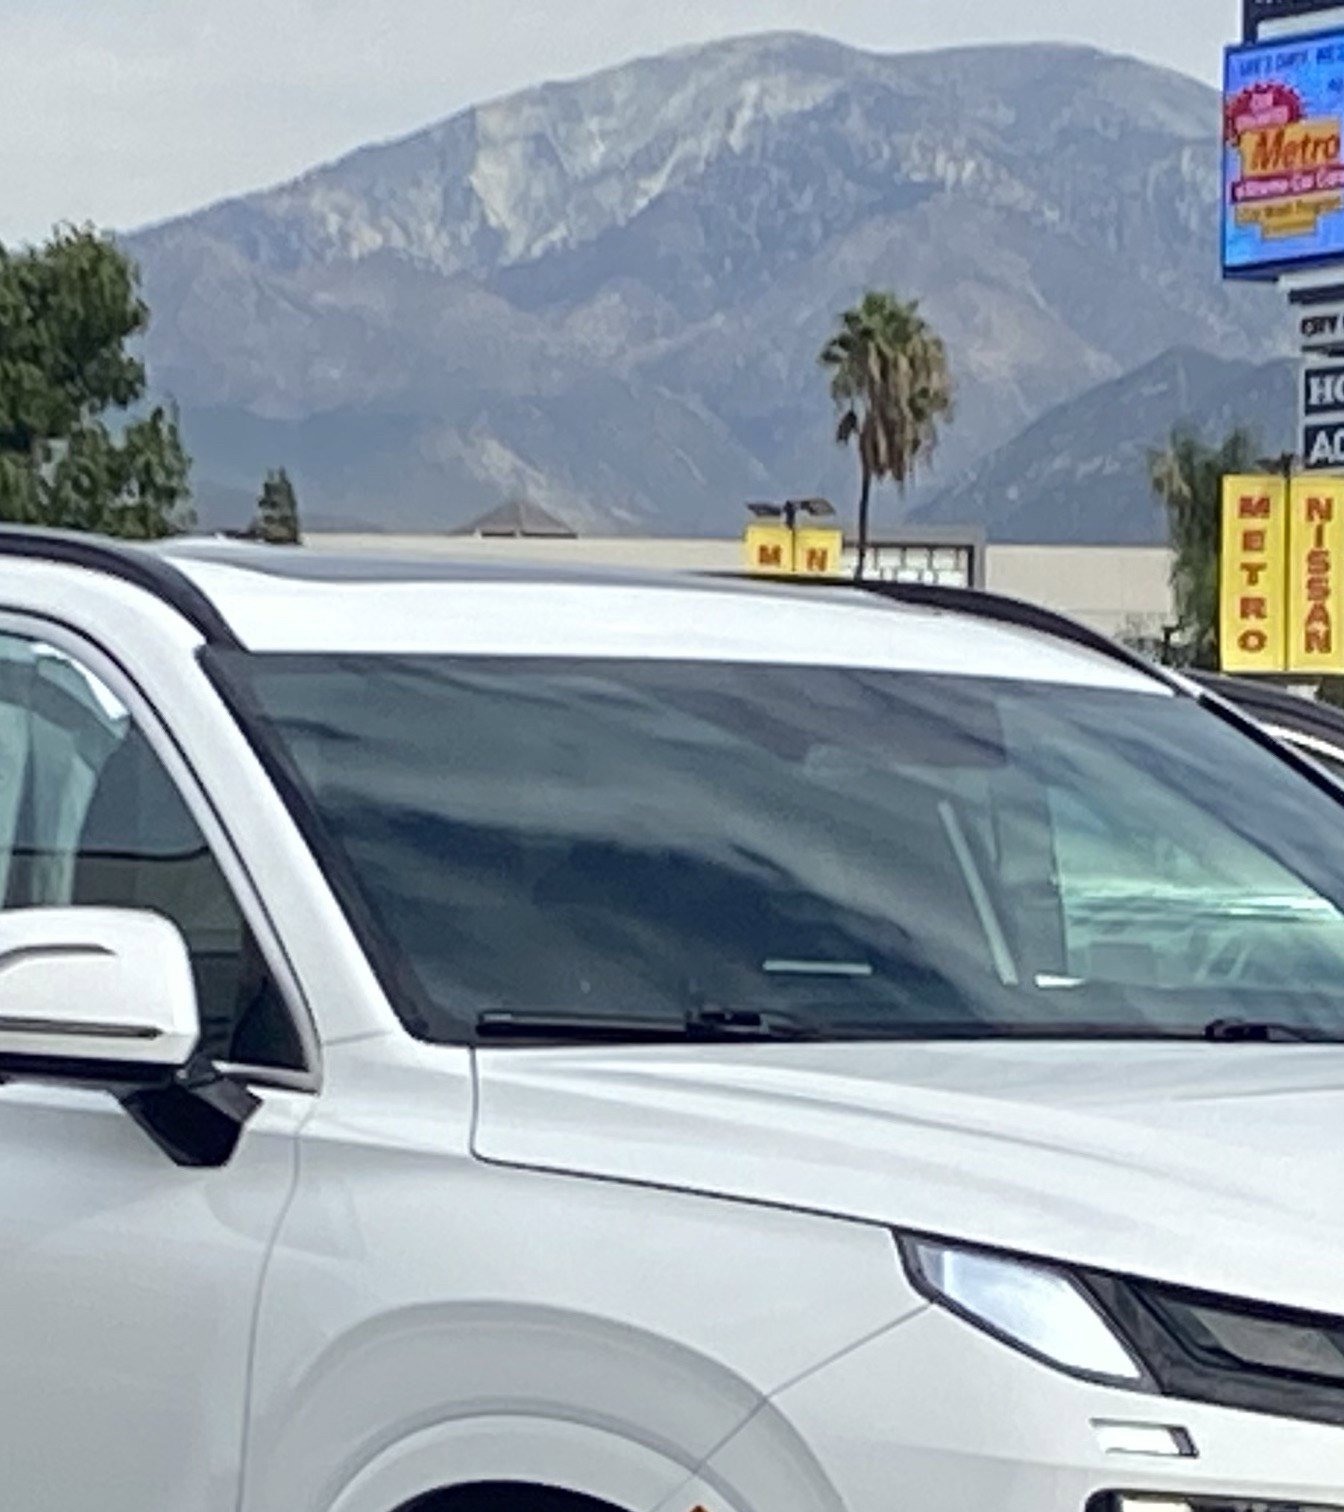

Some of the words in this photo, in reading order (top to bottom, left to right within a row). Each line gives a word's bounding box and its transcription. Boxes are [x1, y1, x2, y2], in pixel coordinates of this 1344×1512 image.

[1250, 129, 1341, 171] Metro
[1301, 315, 1337, 336] CITY
[1238, 496, 1270, 652] METRO
[1305, 497, 1333, 654] NISSAN
